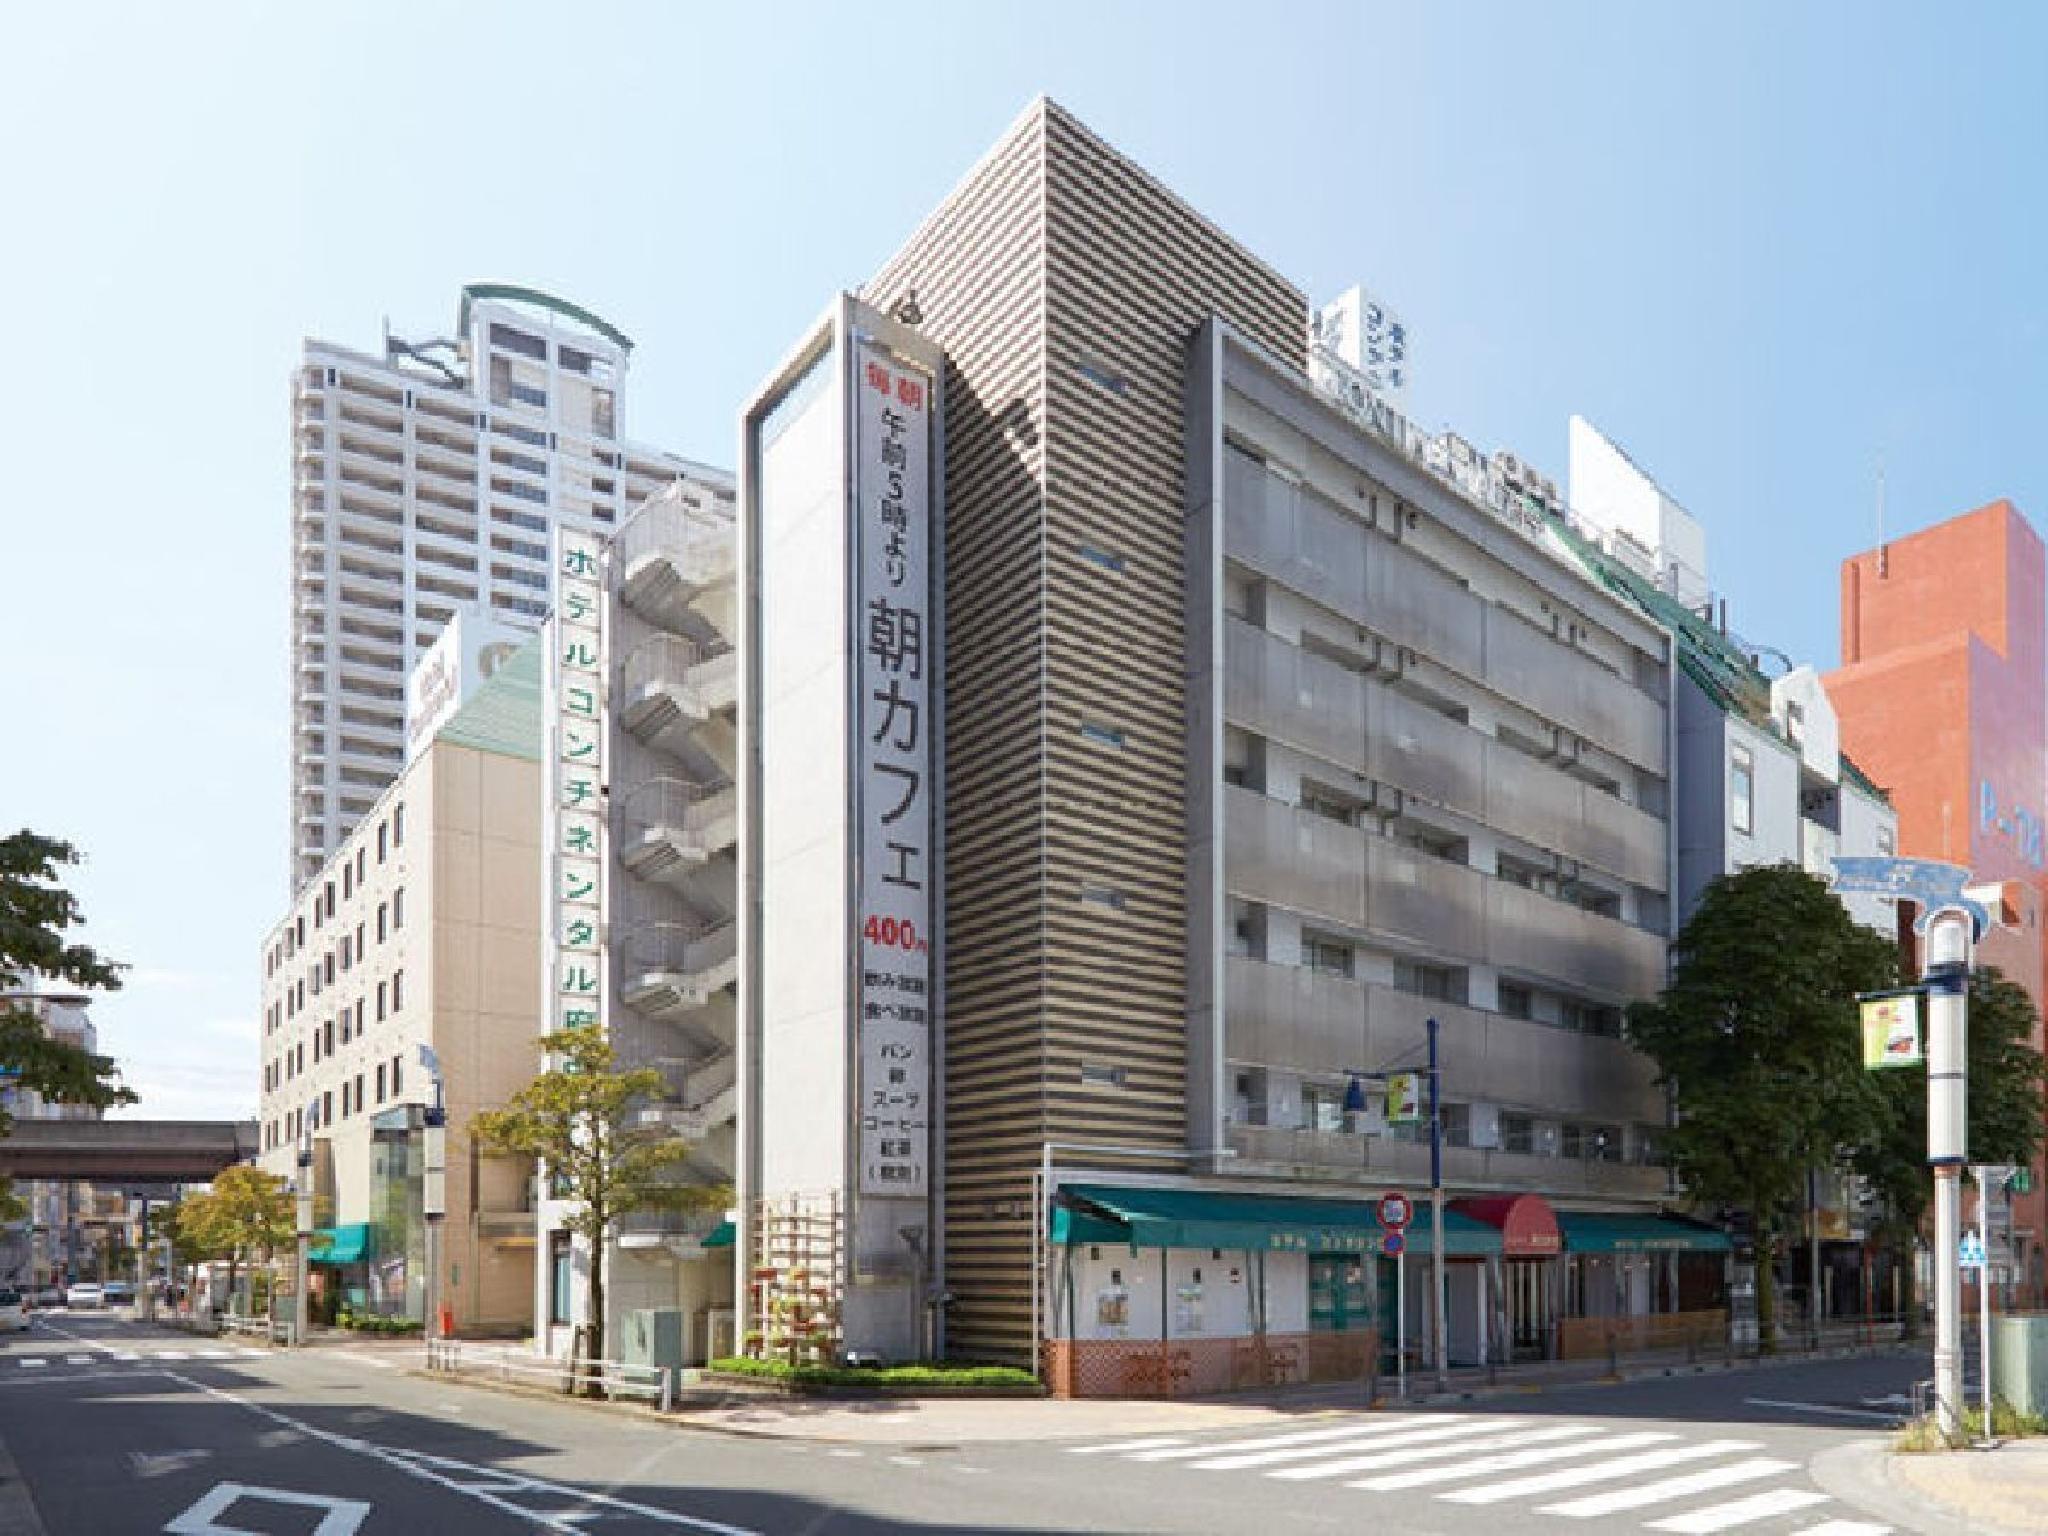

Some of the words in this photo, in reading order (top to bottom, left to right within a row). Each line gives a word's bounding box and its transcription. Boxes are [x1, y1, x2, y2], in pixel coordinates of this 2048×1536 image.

[866, 361, 921, 411] 毎朝
[869, 595, 920, 890] 朝カフェ
[864, 1115, 927, 1133] コーヒー
